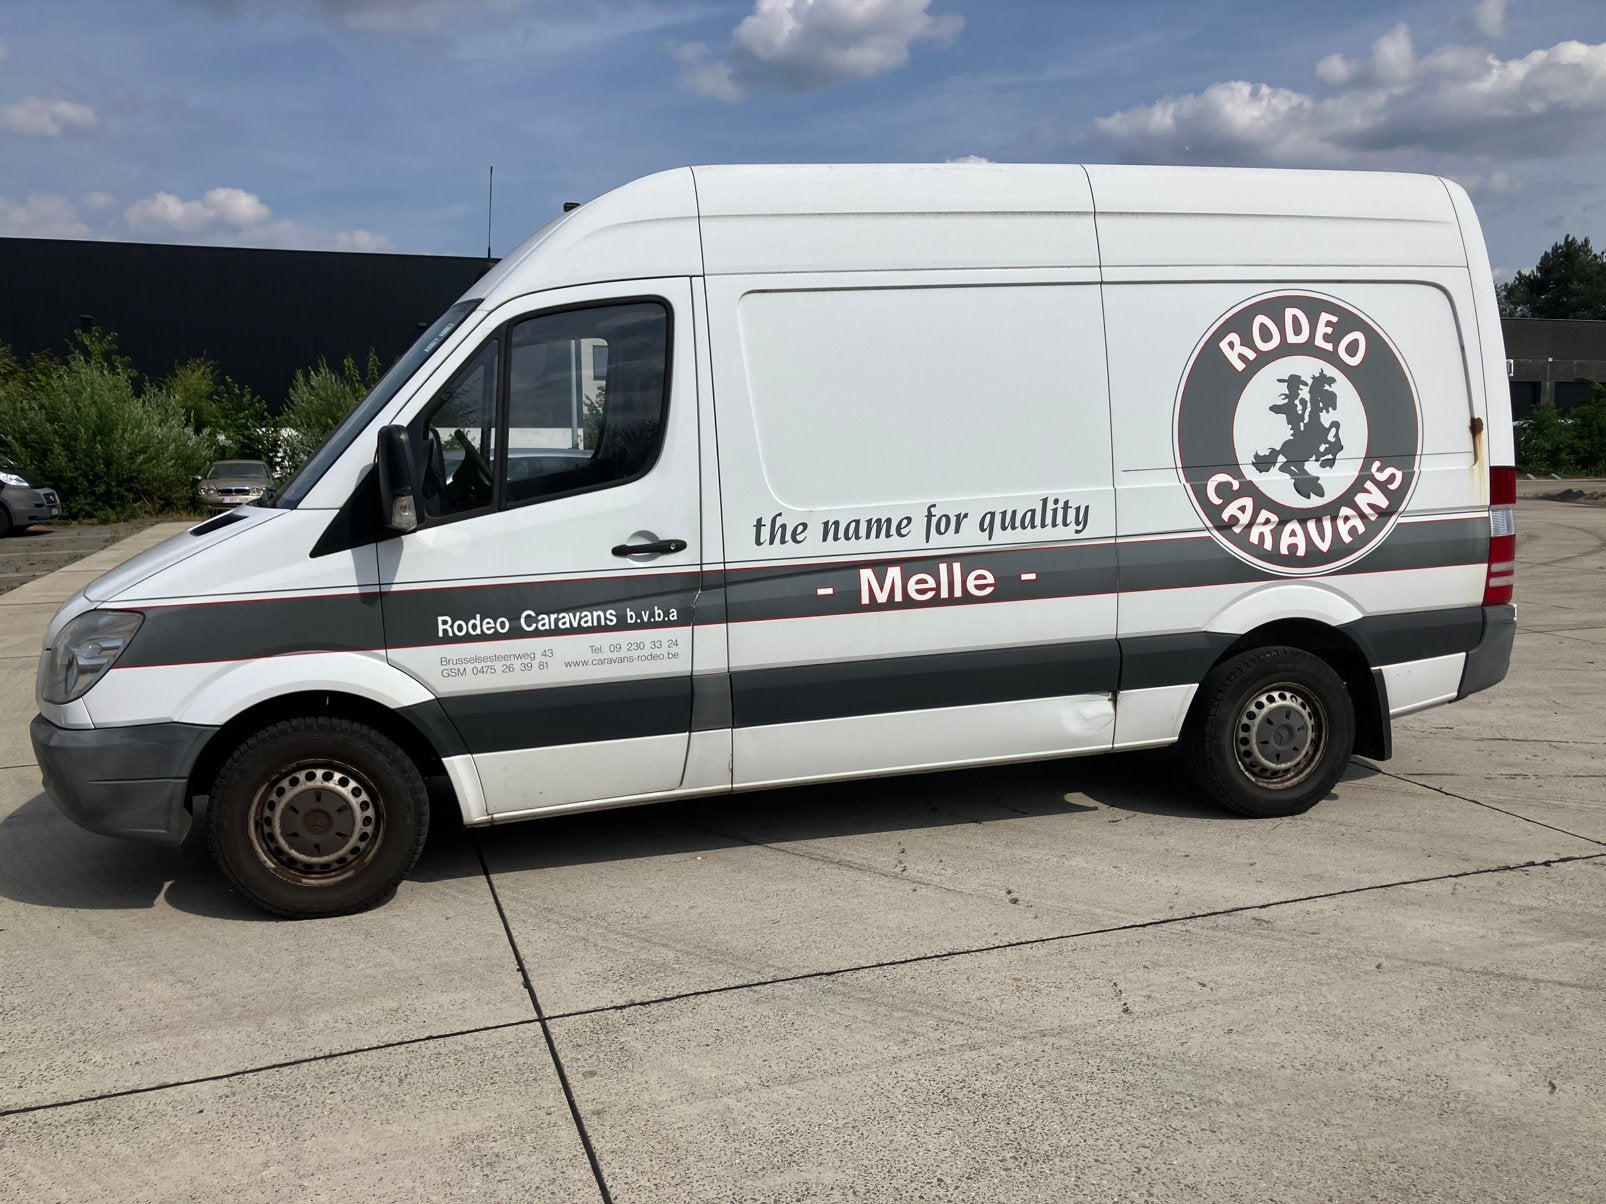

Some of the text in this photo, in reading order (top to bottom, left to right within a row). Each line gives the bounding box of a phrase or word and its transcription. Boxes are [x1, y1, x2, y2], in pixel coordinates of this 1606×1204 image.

[1218, 307, 1367, 373] RODEO
[753, 496, 1090, 547] the name for quality
[1205, 460, 1403, 557] CARAVANS
[858, 561, 996, 606] Melle
[437, 605, 678, 638] Rodeo Caravans b.v.b.a
[440, 648, 554, 667] Brusselsesteenweg 43
[564, 650, 680, 668] www.caravans-rodeo.be
[609, 643, 622, 653] 09
[626, 641, 645, 652] 230
[650, 640, 663, 650] 33
[667, 639, 679, 649] 24
[441, 661, 549, 678] GSM 0475 26 39 81
